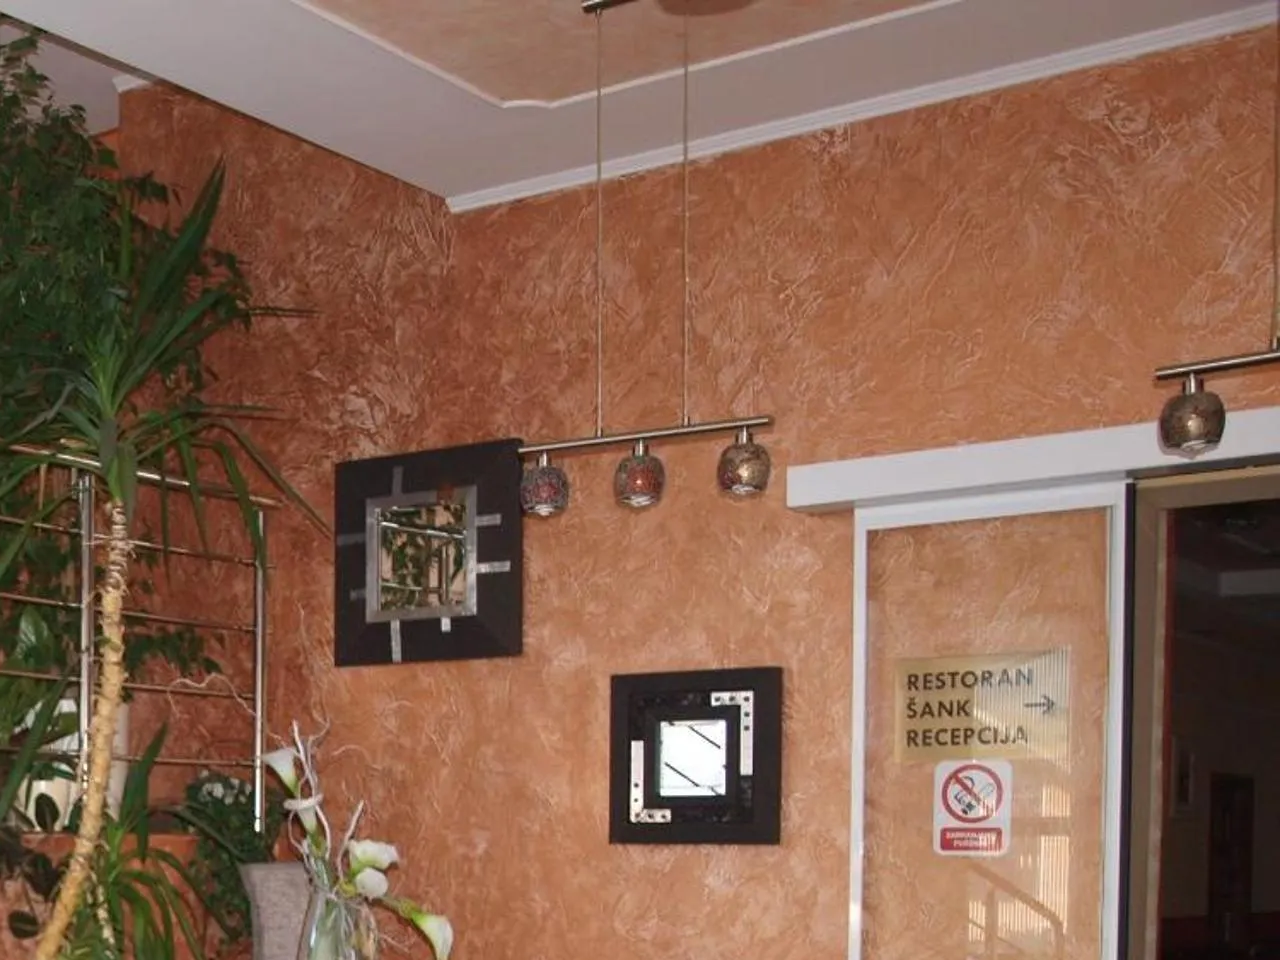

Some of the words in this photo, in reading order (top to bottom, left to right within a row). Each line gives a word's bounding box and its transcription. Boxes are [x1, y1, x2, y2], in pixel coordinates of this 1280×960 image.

[907, 668, 1033, 691] RESTORAN
[906, 697, 971, 719] ŠANK
[906, 725, 1028, 748] RECEPCIJA
